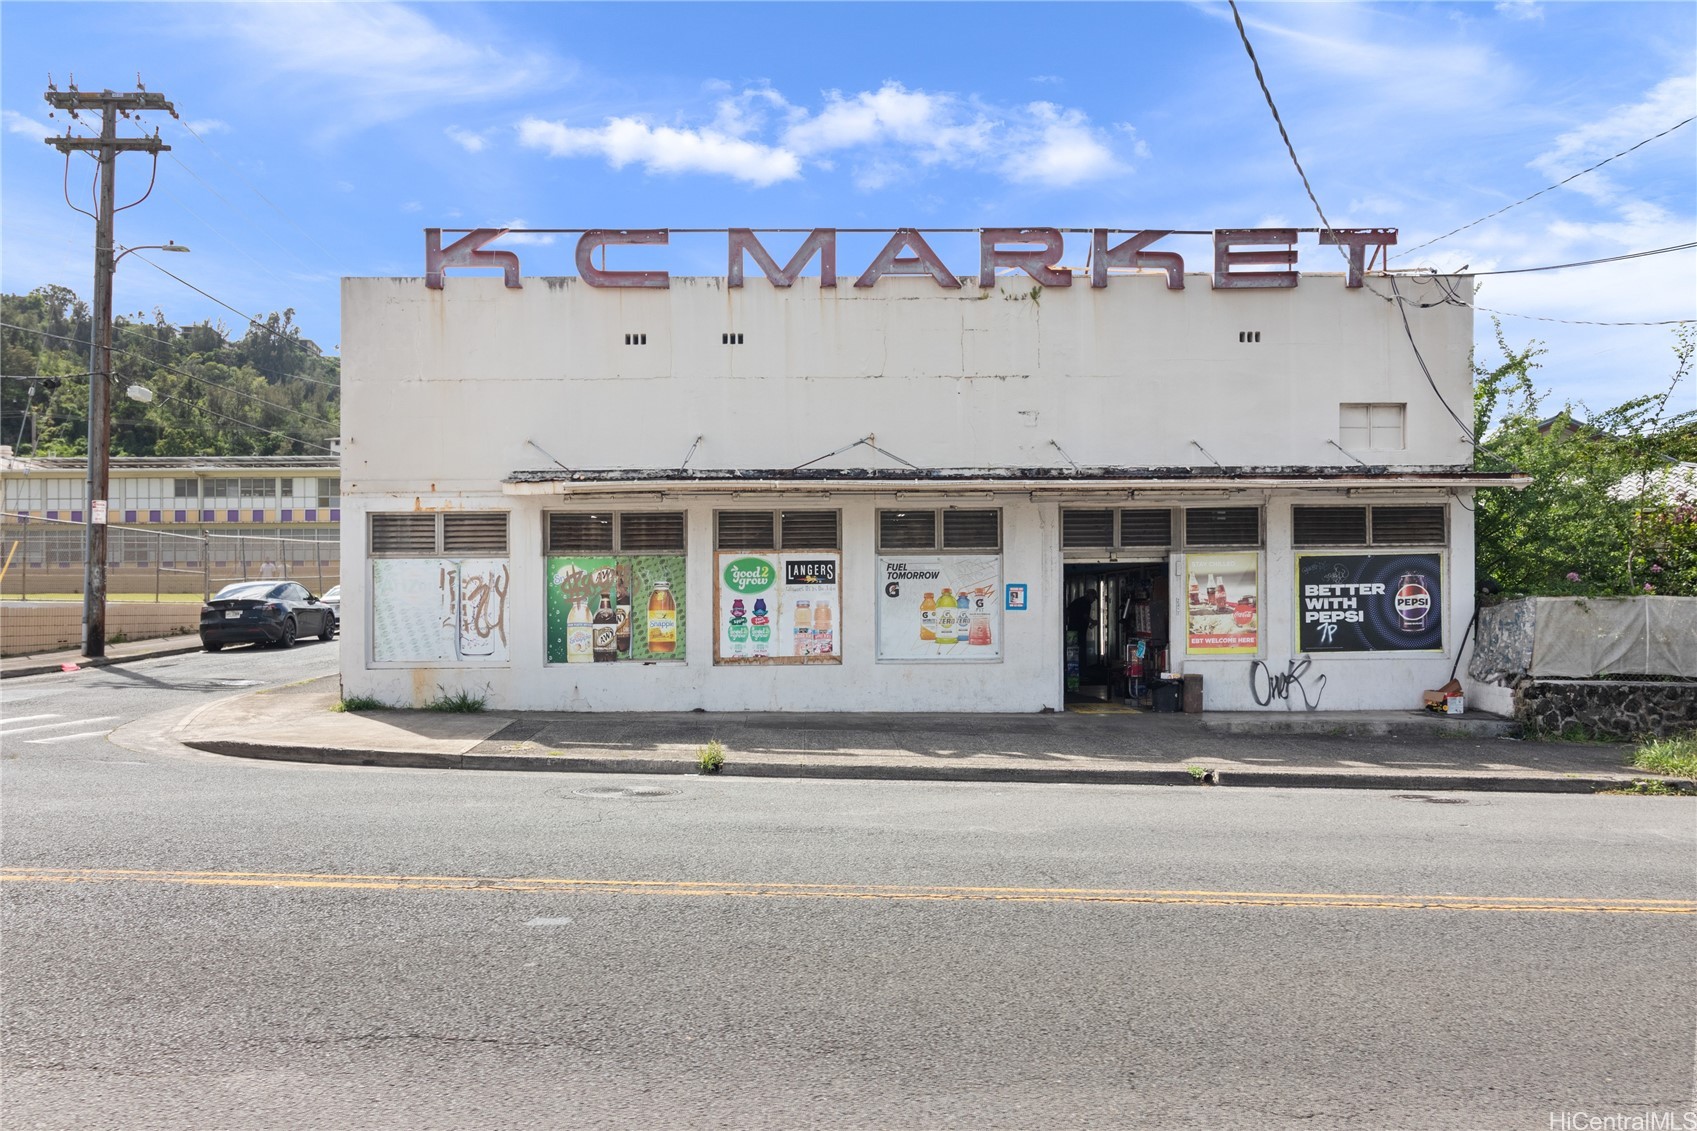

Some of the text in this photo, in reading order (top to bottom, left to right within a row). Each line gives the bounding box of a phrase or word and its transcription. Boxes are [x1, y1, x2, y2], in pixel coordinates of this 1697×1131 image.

[728, 228, 1398, 289] MARKET
[788, 564, 834, 580] LANGERS
[886, 563, 908, 571] FUEL
[887, 571, 940, 580] TOMORROW
[739, 577, 769, 590] grow
[885, 581, 900, 598] G
[1305, 583, 1386, 597] BETTER
[1305, 597, 1357, 610] WITH
[1397, 598, 1429, 606] PEPSI
[1305, 610, 1364, 623] PEPSI
[650, 620, 675, 629] Snapple
